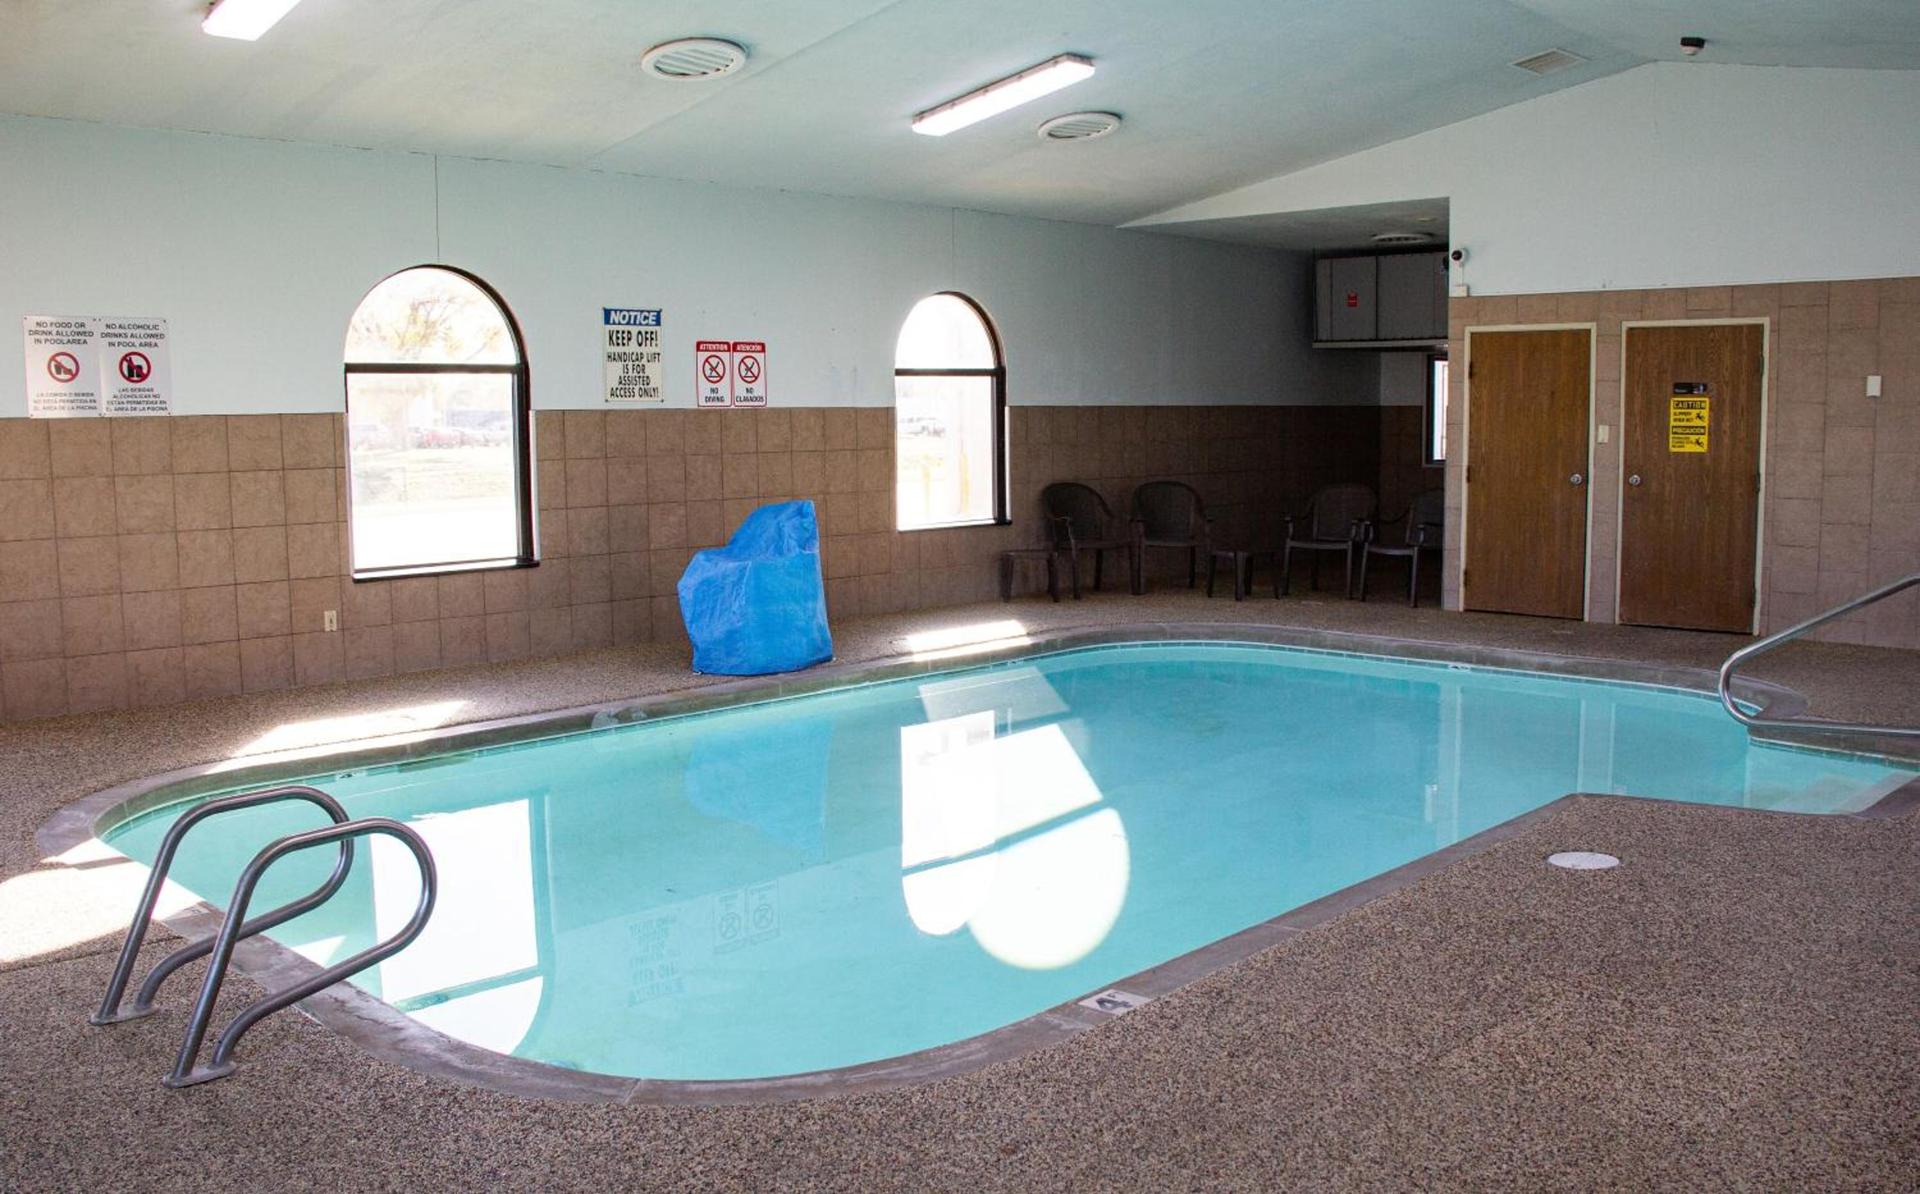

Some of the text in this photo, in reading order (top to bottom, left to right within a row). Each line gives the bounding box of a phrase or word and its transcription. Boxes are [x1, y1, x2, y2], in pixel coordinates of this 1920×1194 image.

[609, 310, 658, 325] NOTICE
[35, 321, 86, 330] NO FOOD OR
[118, 323, 160, 331] ALCOHOLIC
[28, 329, 94, 338] DRINK ALLOWED
[129, 332, 165, 340] ALLOWED
[608, 329, 658, 347] KEEP OFF!
[699, 343, 728, 351] ATTENTION
[607, 351, 661, 363] HANDICAP LIFT
[622, 363, 646, 375] IS FOR
[618, 375, 651, 386] ASSISTED
[610, 387, 659, 398] ACCESS ONLY!
[704, 395, 725, 403] DIVING
[735, 395, 764, 403] CLAVADOS
[1673, 401, 1707, 409] CAUTION
